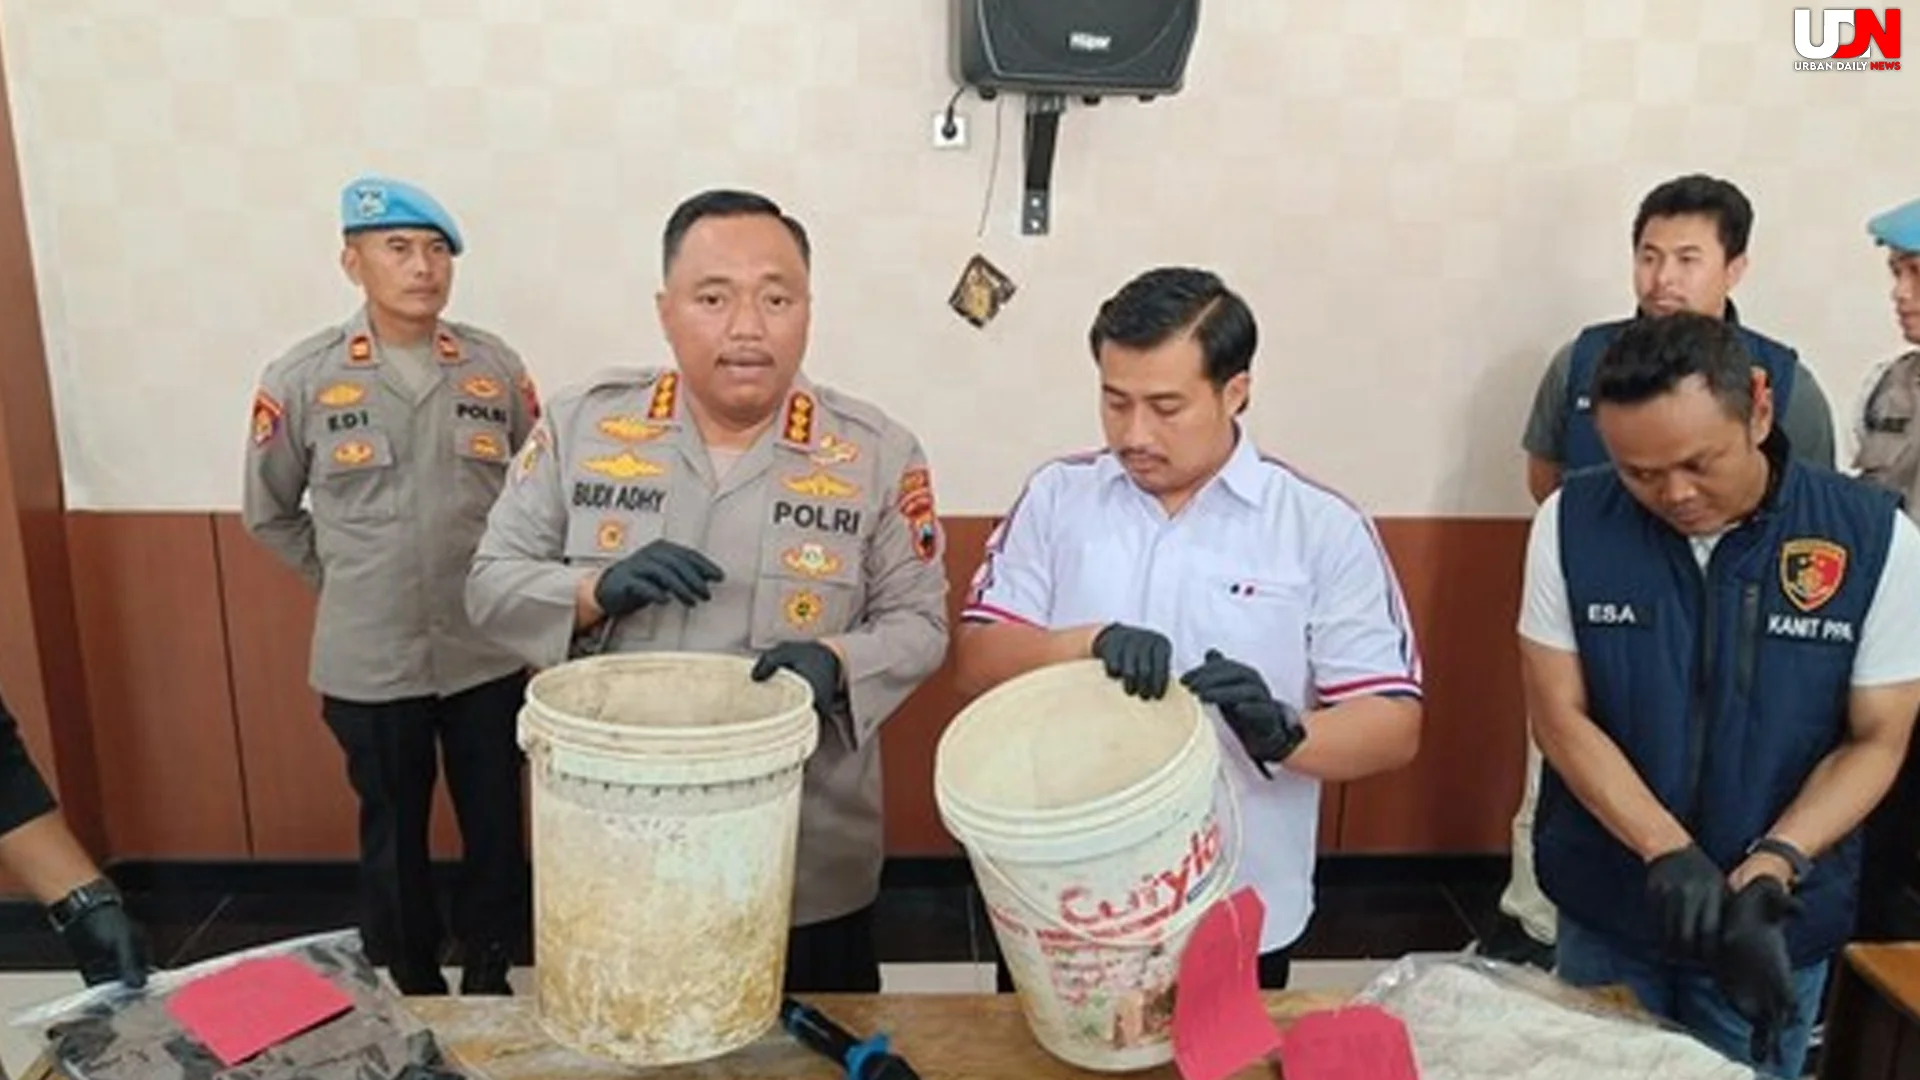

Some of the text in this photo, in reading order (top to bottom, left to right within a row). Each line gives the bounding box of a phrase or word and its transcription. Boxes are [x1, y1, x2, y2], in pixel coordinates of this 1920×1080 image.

[457, 402, 507, 423] POLRI
[572, 482, 614, 508] BUDI
[772, 501, 860, 536] POLRI
[1588, 603, 1637, 624] ESA
[1767, 613, 1821, 638] KANIT
